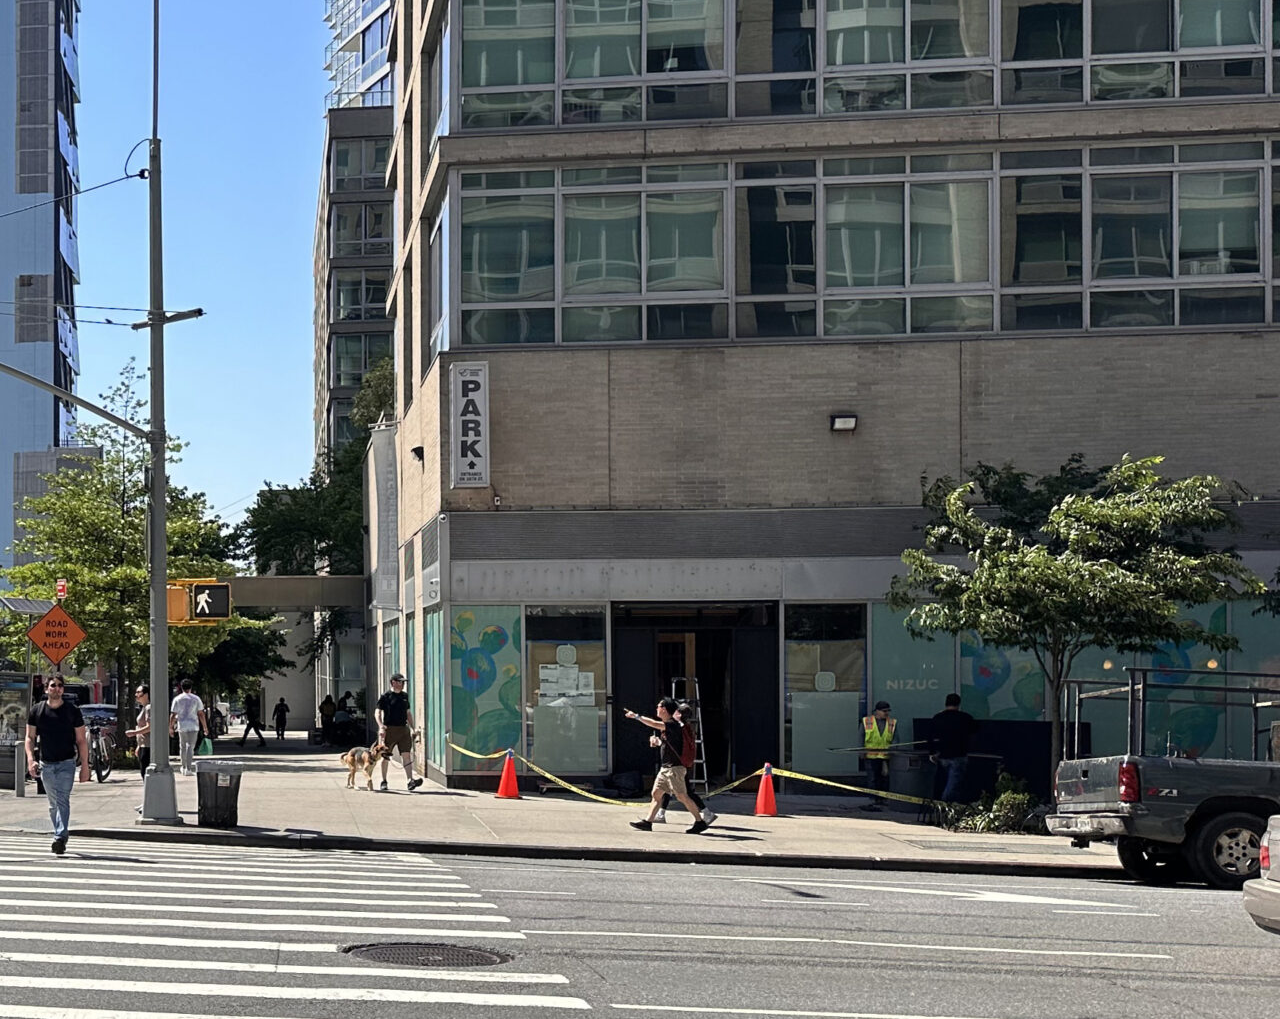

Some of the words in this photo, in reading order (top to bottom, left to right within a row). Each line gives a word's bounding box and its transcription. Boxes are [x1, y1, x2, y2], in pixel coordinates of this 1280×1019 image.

[460, 380, 482, 458] PARK
[45, 620, 68, 628] ROAD
[42, 641, 70, 649] AHEAD
[886, 679, 938, 690] NIZUC
